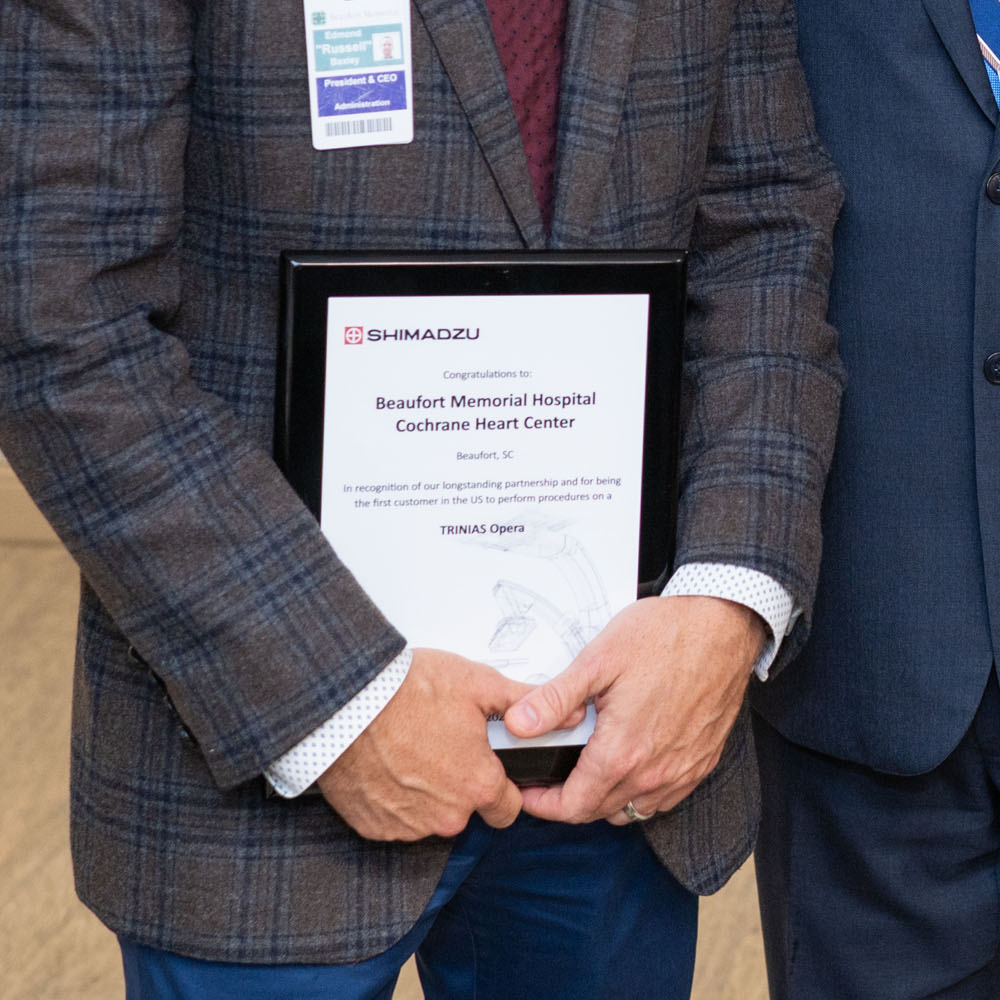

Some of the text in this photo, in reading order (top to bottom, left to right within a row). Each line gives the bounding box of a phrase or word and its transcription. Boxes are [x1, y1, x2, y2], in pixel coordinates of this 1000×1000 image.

[324, 78, 366, 87] President
[378, 74, 397, 82] CEO
[334, 100, 390, 111] Administration
[368, 328, 479, 341] SHIMADZU
[443, 370, 517, 381] Congratulations
[376, 392, 595, 409] Beaufort Memorial Hospital
[396, 417, 575, 432] Cochrane Heart Center
[457, 450, 514, 460] Beaufort, SC
[355, 483, 408, 494] recognition
[411, 482, 421, 490] of
[443, 480, 502, 491] longstanding
[505, 478, 558, 489] partnership
[561, 478, 578, 486] and
[581, 477, 593, 485] for
[596, 477, 621, 486] being
[354, 499, 370, 508] the
[373, 498, 391, 507] first
[452, 496, 468, 504] the
[471, 496, 483, 504] US
[498, 494, 535, 504] perform
[538, 493, 590, 503] procedures
[440, 524, 524, 535] TRINIAS Opera
[486, 712, 504, 721] 202
